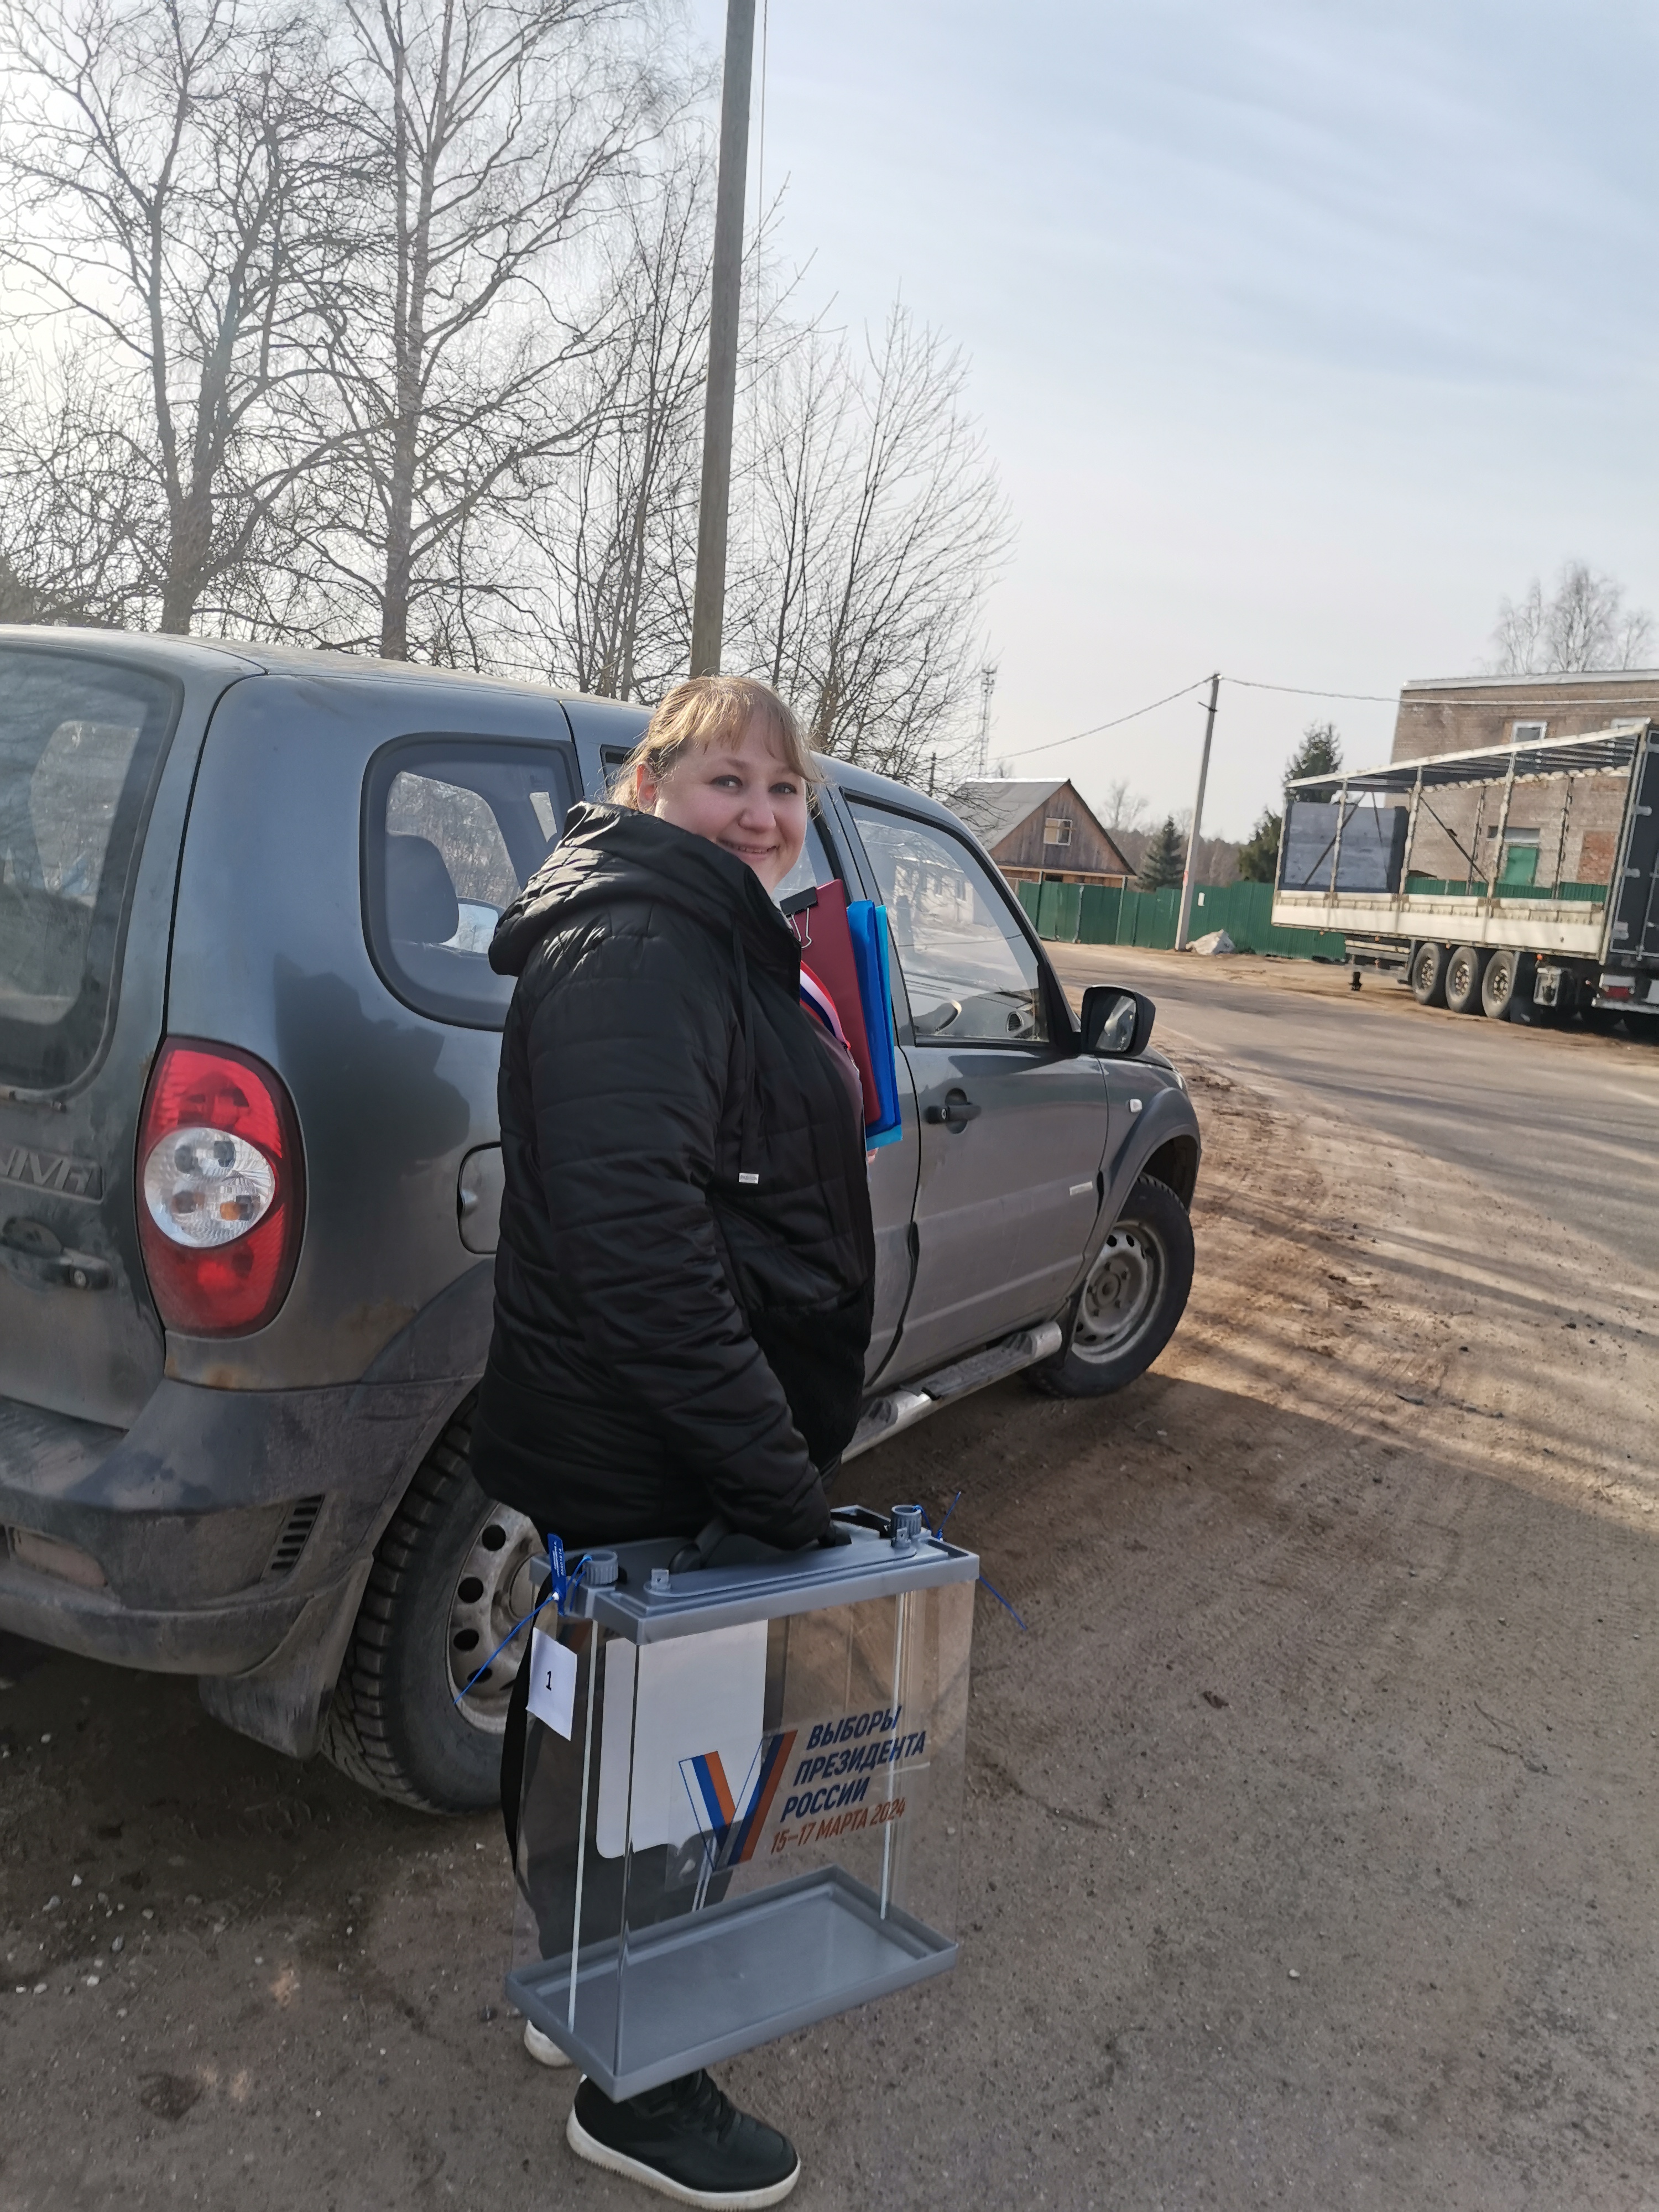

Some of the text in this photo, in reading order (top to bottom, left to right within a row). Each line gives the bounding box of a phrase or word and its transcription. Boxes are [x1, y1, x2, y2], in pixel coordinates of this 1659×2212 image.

[546, 1671, 552, 1692] 1
[806, 1705, 902, 1751] ВЫБОРЫ
[793, 1731, 927, 1787] ПРЕЗИДЕНТА
[780, 1776, 870, 1823] РОССИИ
[815, 1808, 869, 1841] МАРТА
[869, 1797, 906, 1826] 2024
